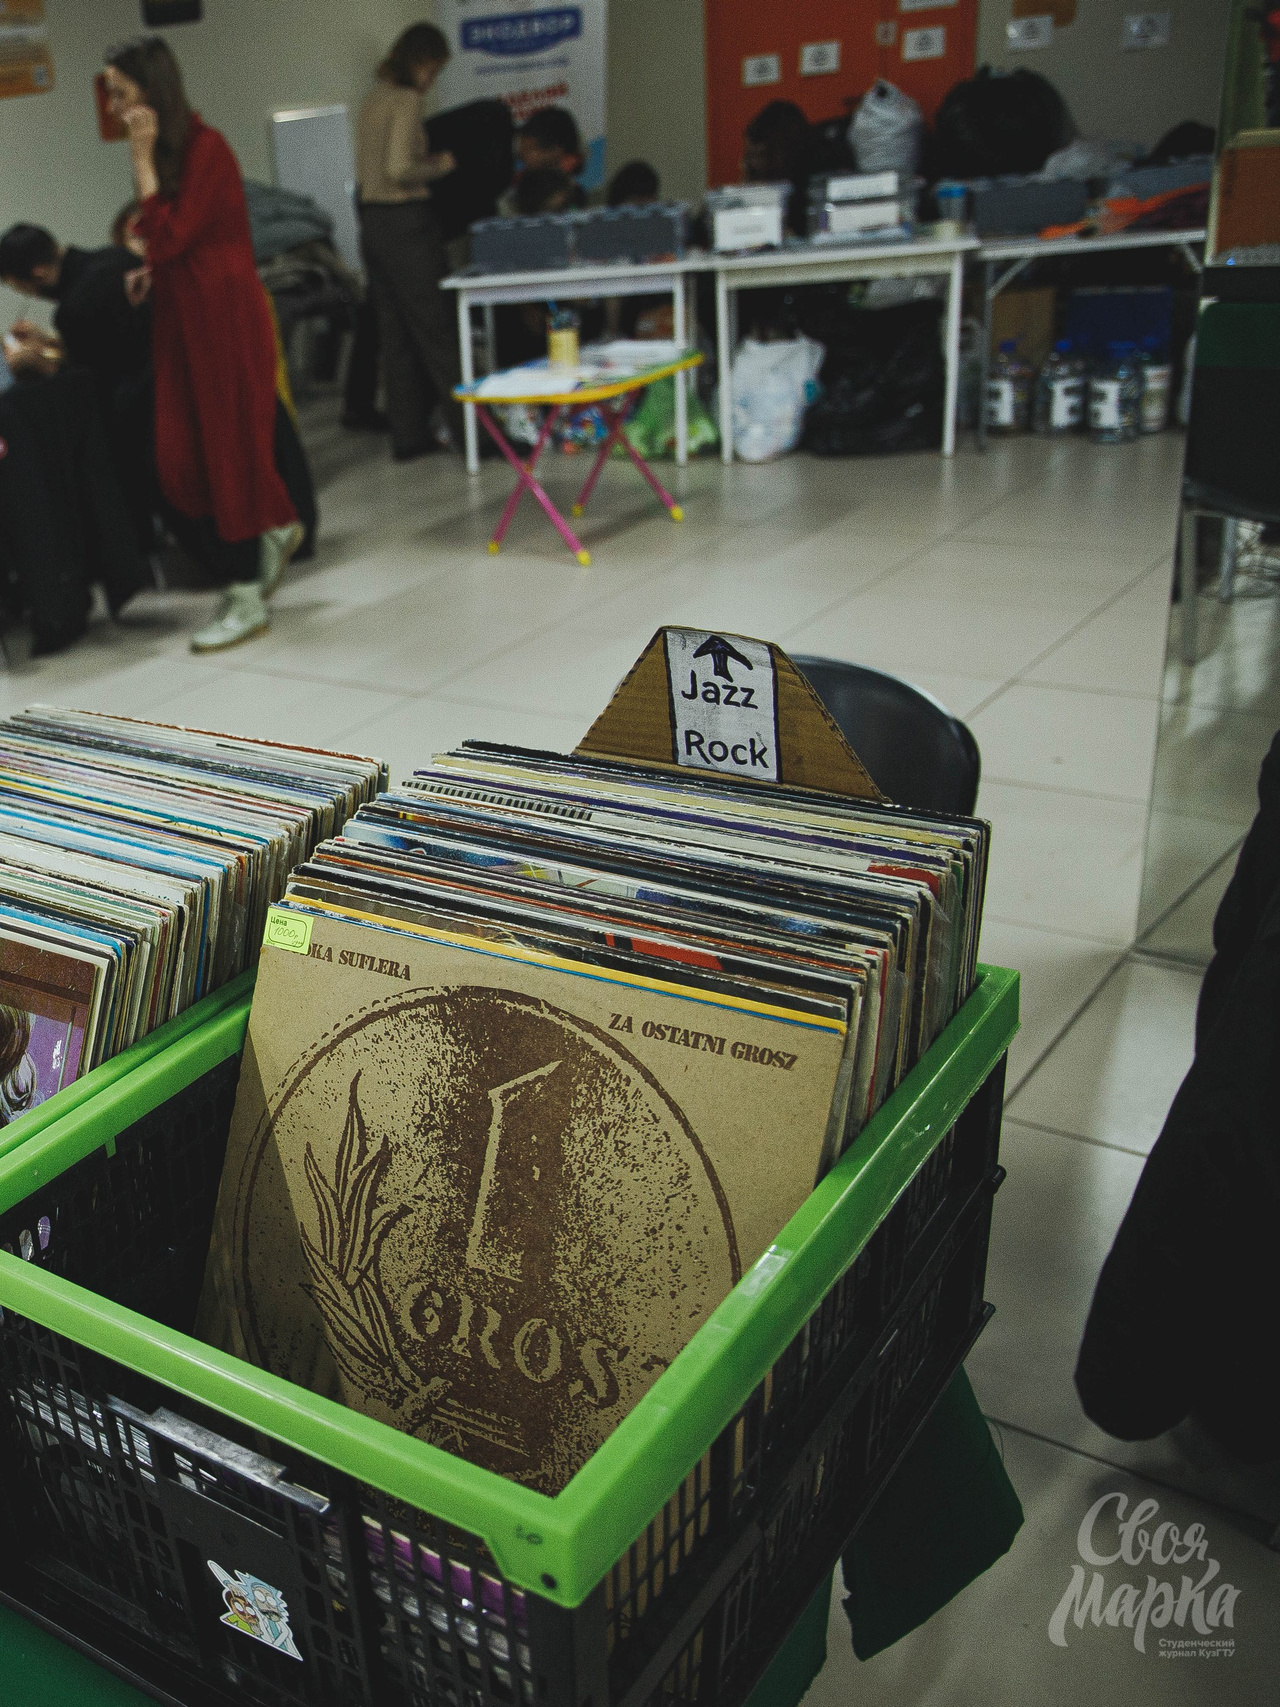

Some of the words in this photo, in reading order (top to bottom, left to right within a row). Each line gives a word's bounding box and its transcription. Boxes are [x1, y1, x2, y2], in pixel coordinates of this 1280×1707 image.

[681, 670, 758, 709] Jazz
[684, 729, 769, 768] Rock
[271, 916, 287, 926] Цена
[339, 950, 411, 981] SUFLERA
[608, 1013, 633, 1033] ZA
[641, 1021, 727, 1055] OSTATNI
[730, 1042, 799, 1070] GROSZ
